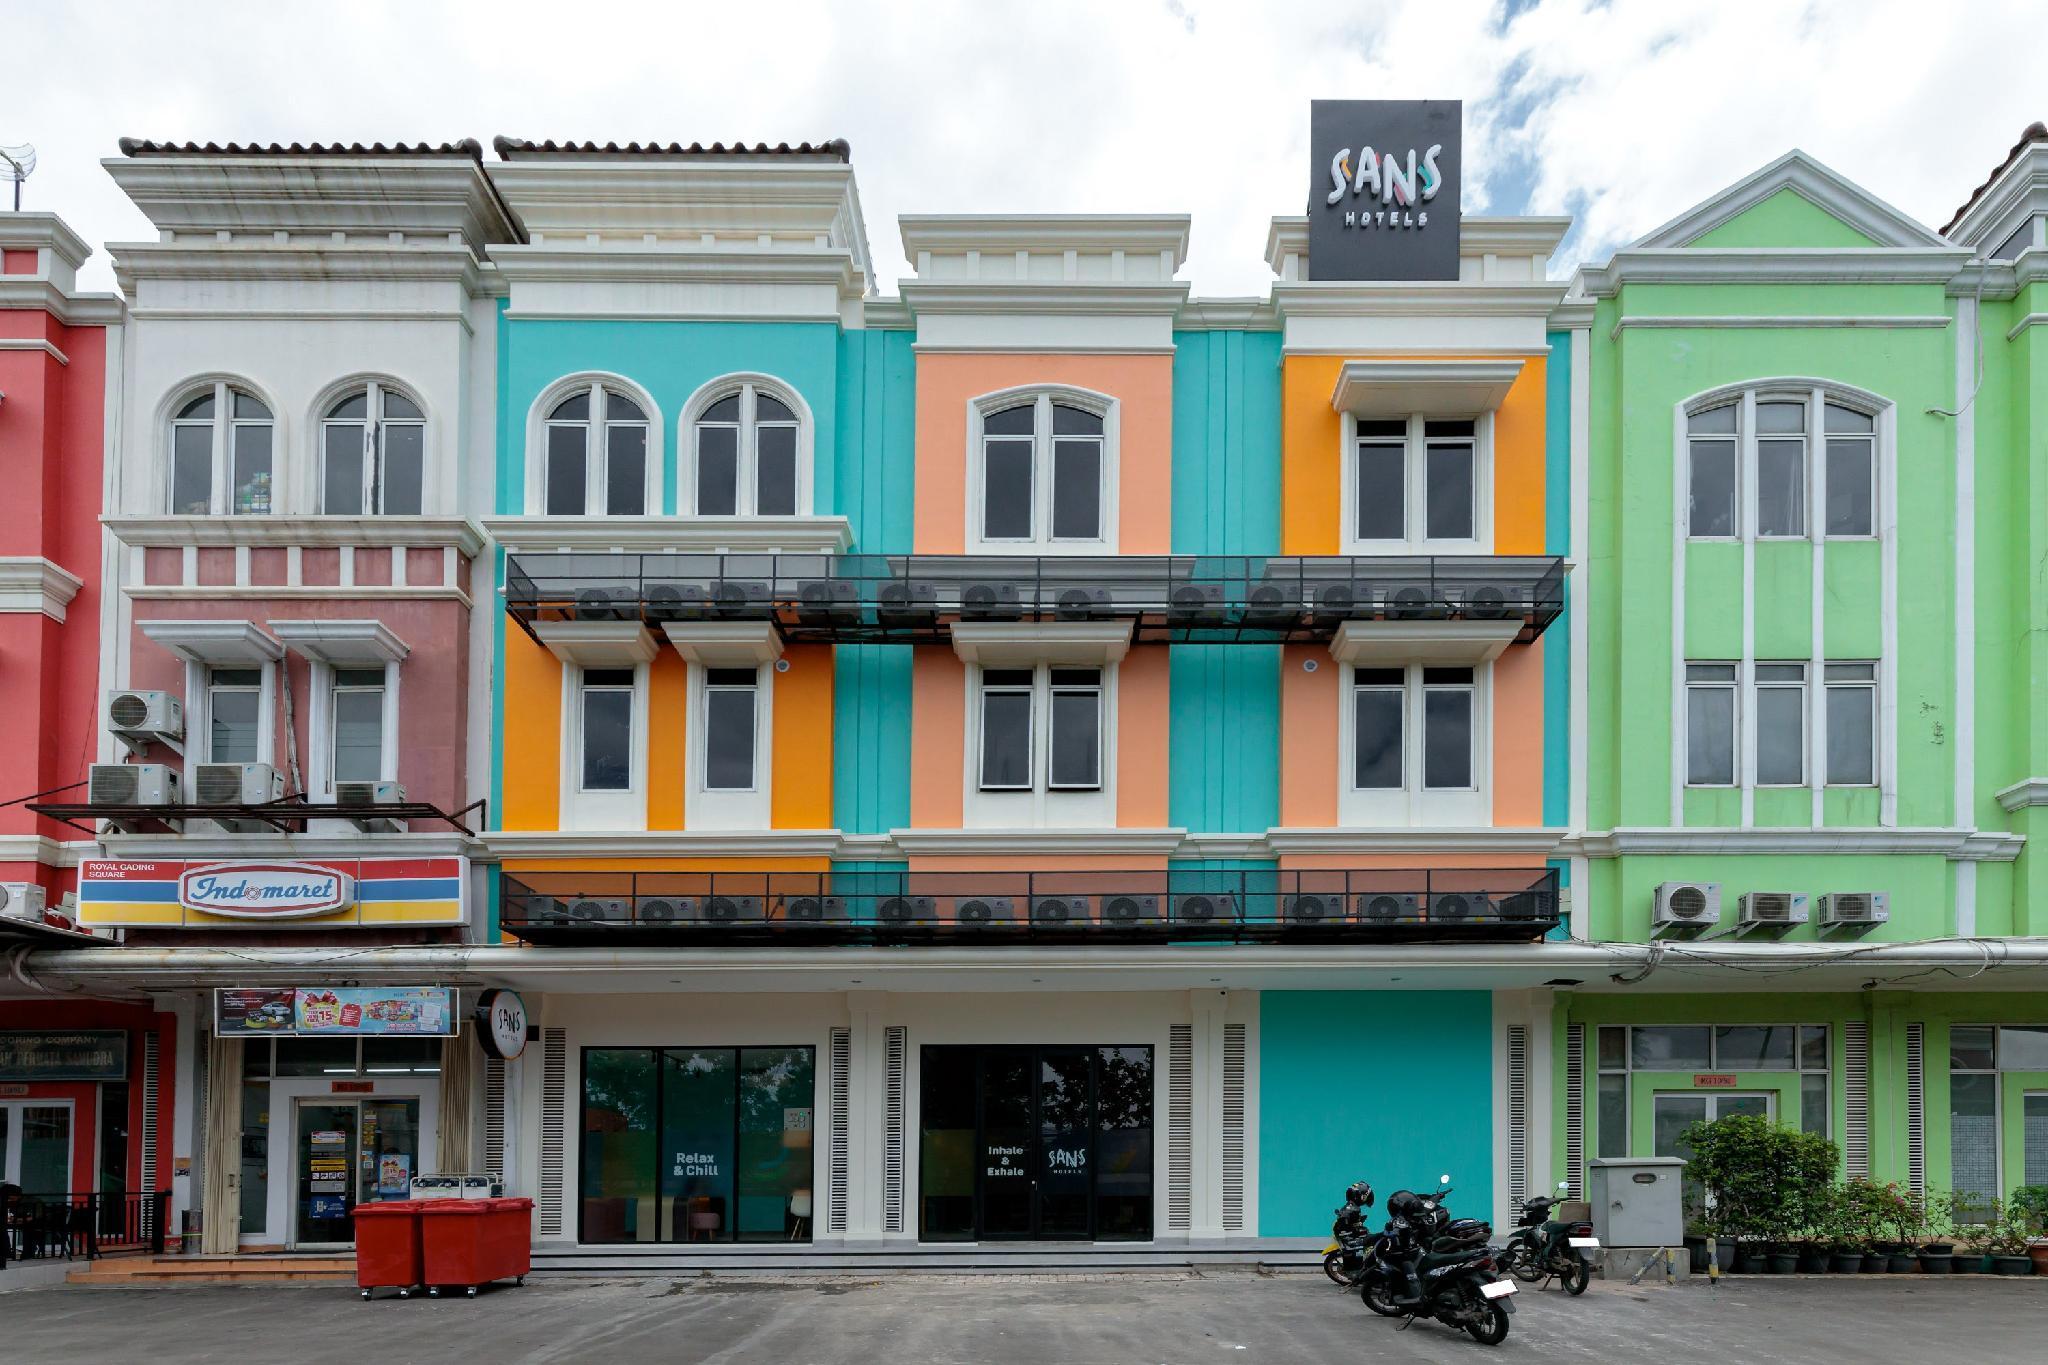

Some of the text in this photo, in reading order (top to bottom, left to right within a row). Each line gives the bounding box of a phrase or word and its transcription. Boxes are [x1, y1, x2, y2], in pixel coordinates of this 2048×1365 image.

[1327, 144, 1442, 207] SANS
[1344, 211, 1428, 227] HOTELS
[89, 863, 118, 871] ROYAL
[191, 877, 333, 900] Indomaret
[498, 1008, 520, 1033] SANS
[988, 1146, 1024, 1155] Inhale
[676, 1152, 714, 1163] Relax
[1001, 1156, 1010, 1165] &
[1048, 1148, 1086, 1168] SANS
[673, 1164, 719, 1176] & Chill
[987, 1167, 1024, 1176] Exhale
